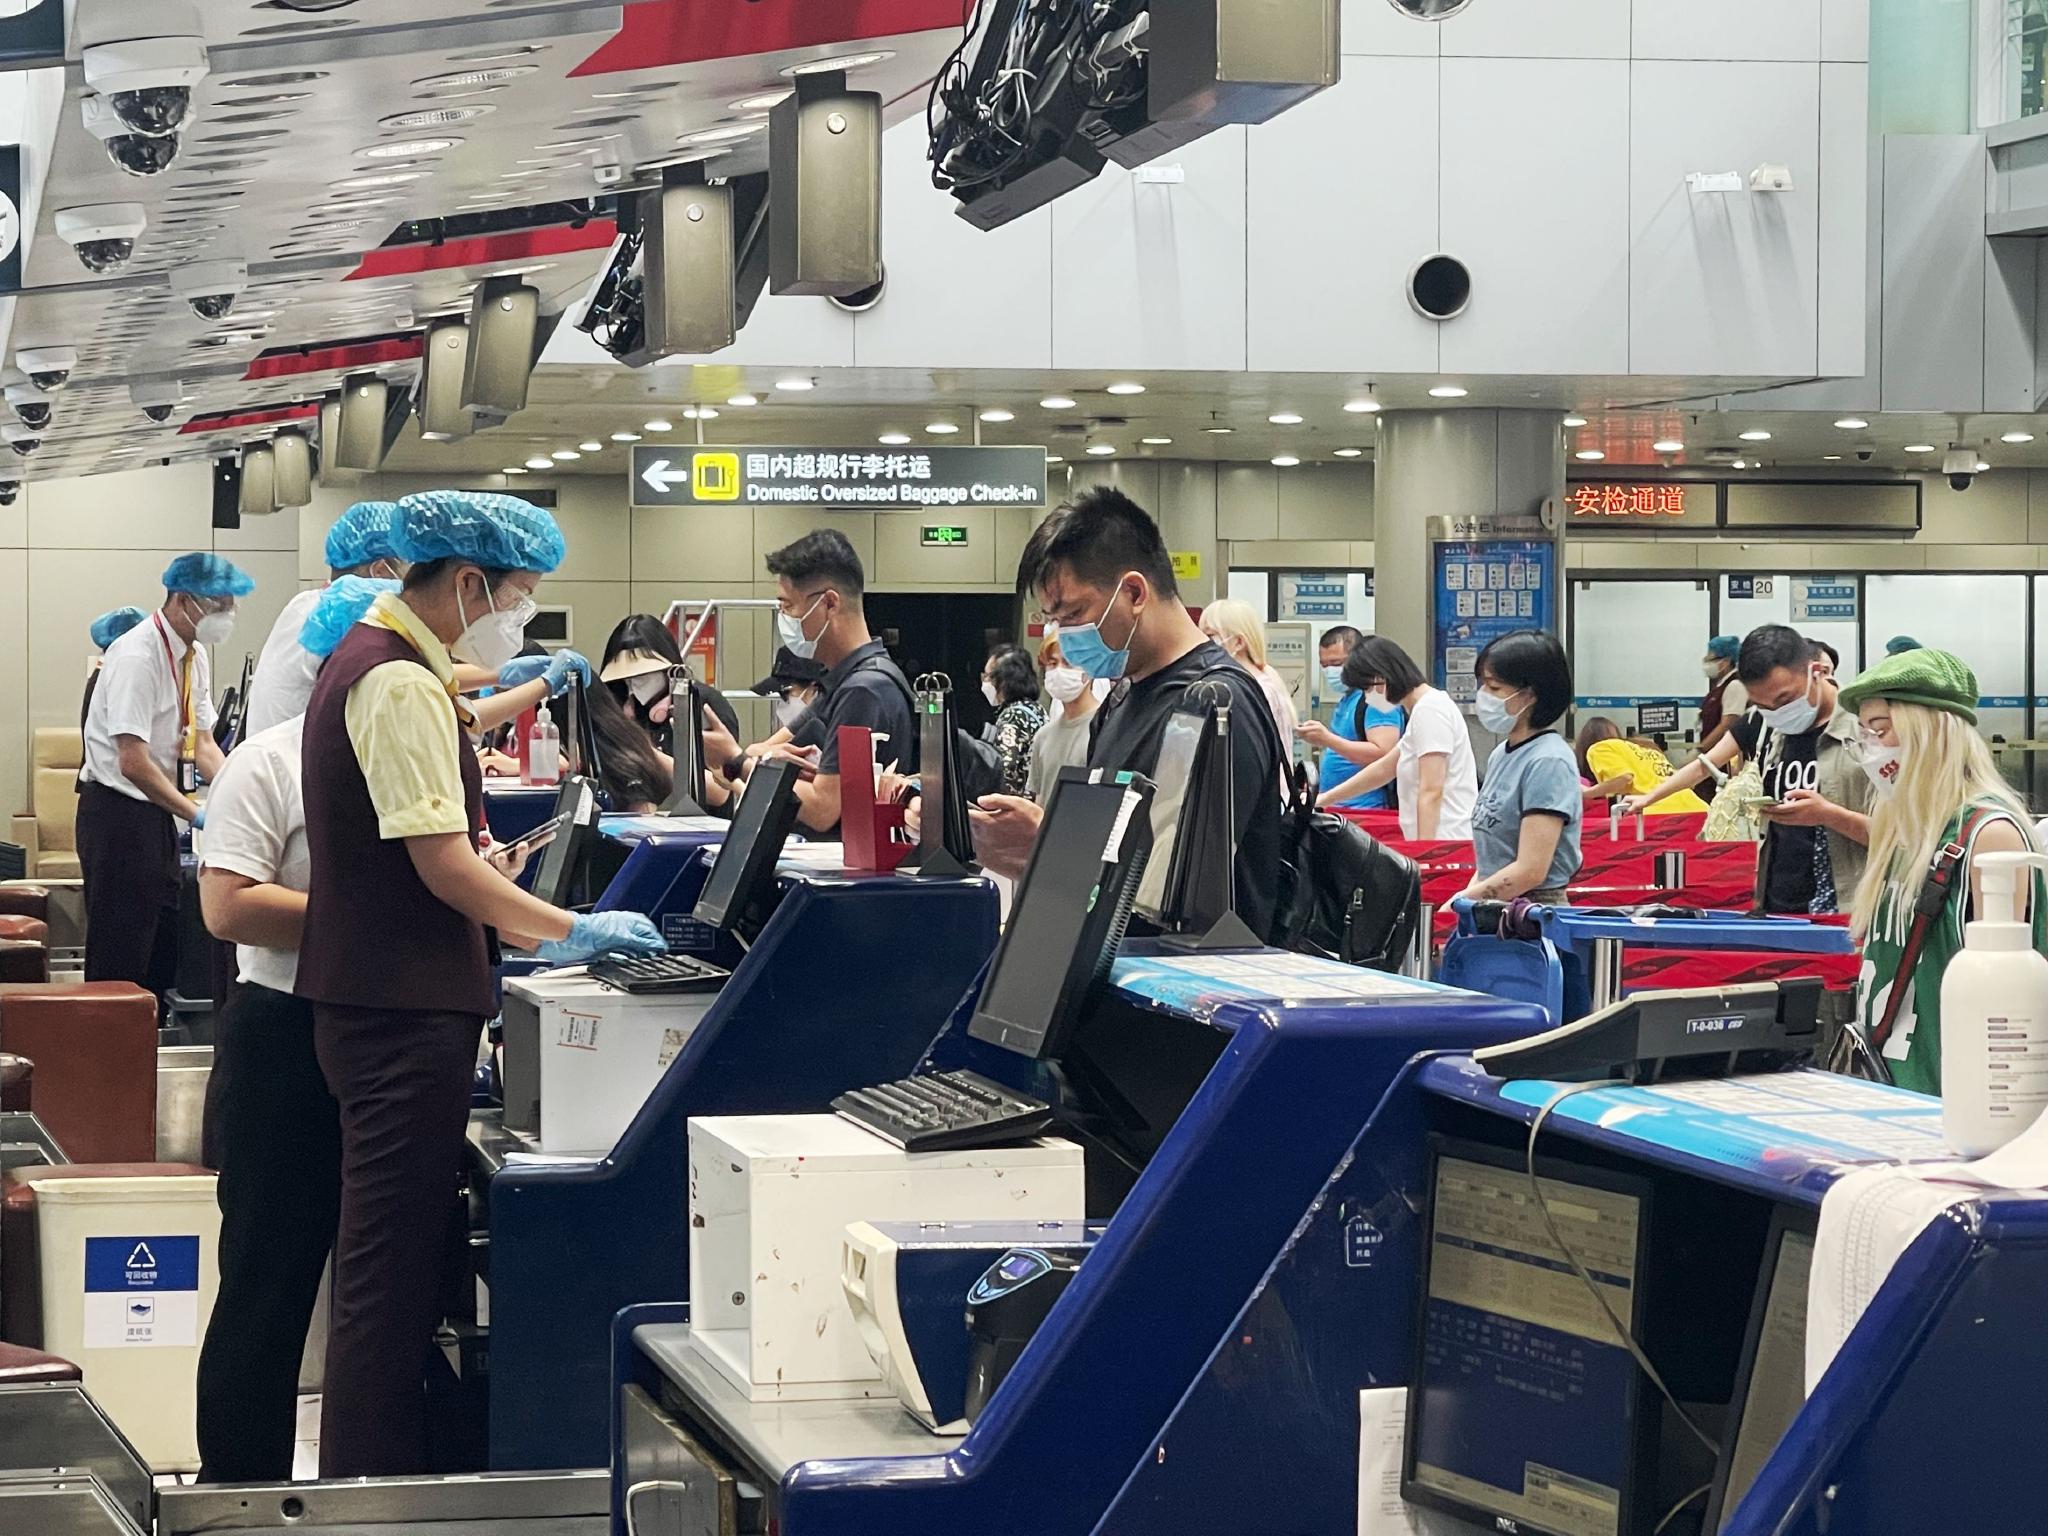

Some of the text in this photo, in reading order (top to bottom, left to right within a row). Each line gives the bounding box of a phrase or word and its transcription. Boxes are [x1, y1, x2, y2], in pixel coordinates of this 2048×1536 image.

[746, 454, 931, 479] 国内超规行李托运
[747, 484, 1037, 504] Domestic Oversized Baggage Check-in
[1565, 485, 1685, 515] 安检通道
[1755, 581, 1773, 594] 20
